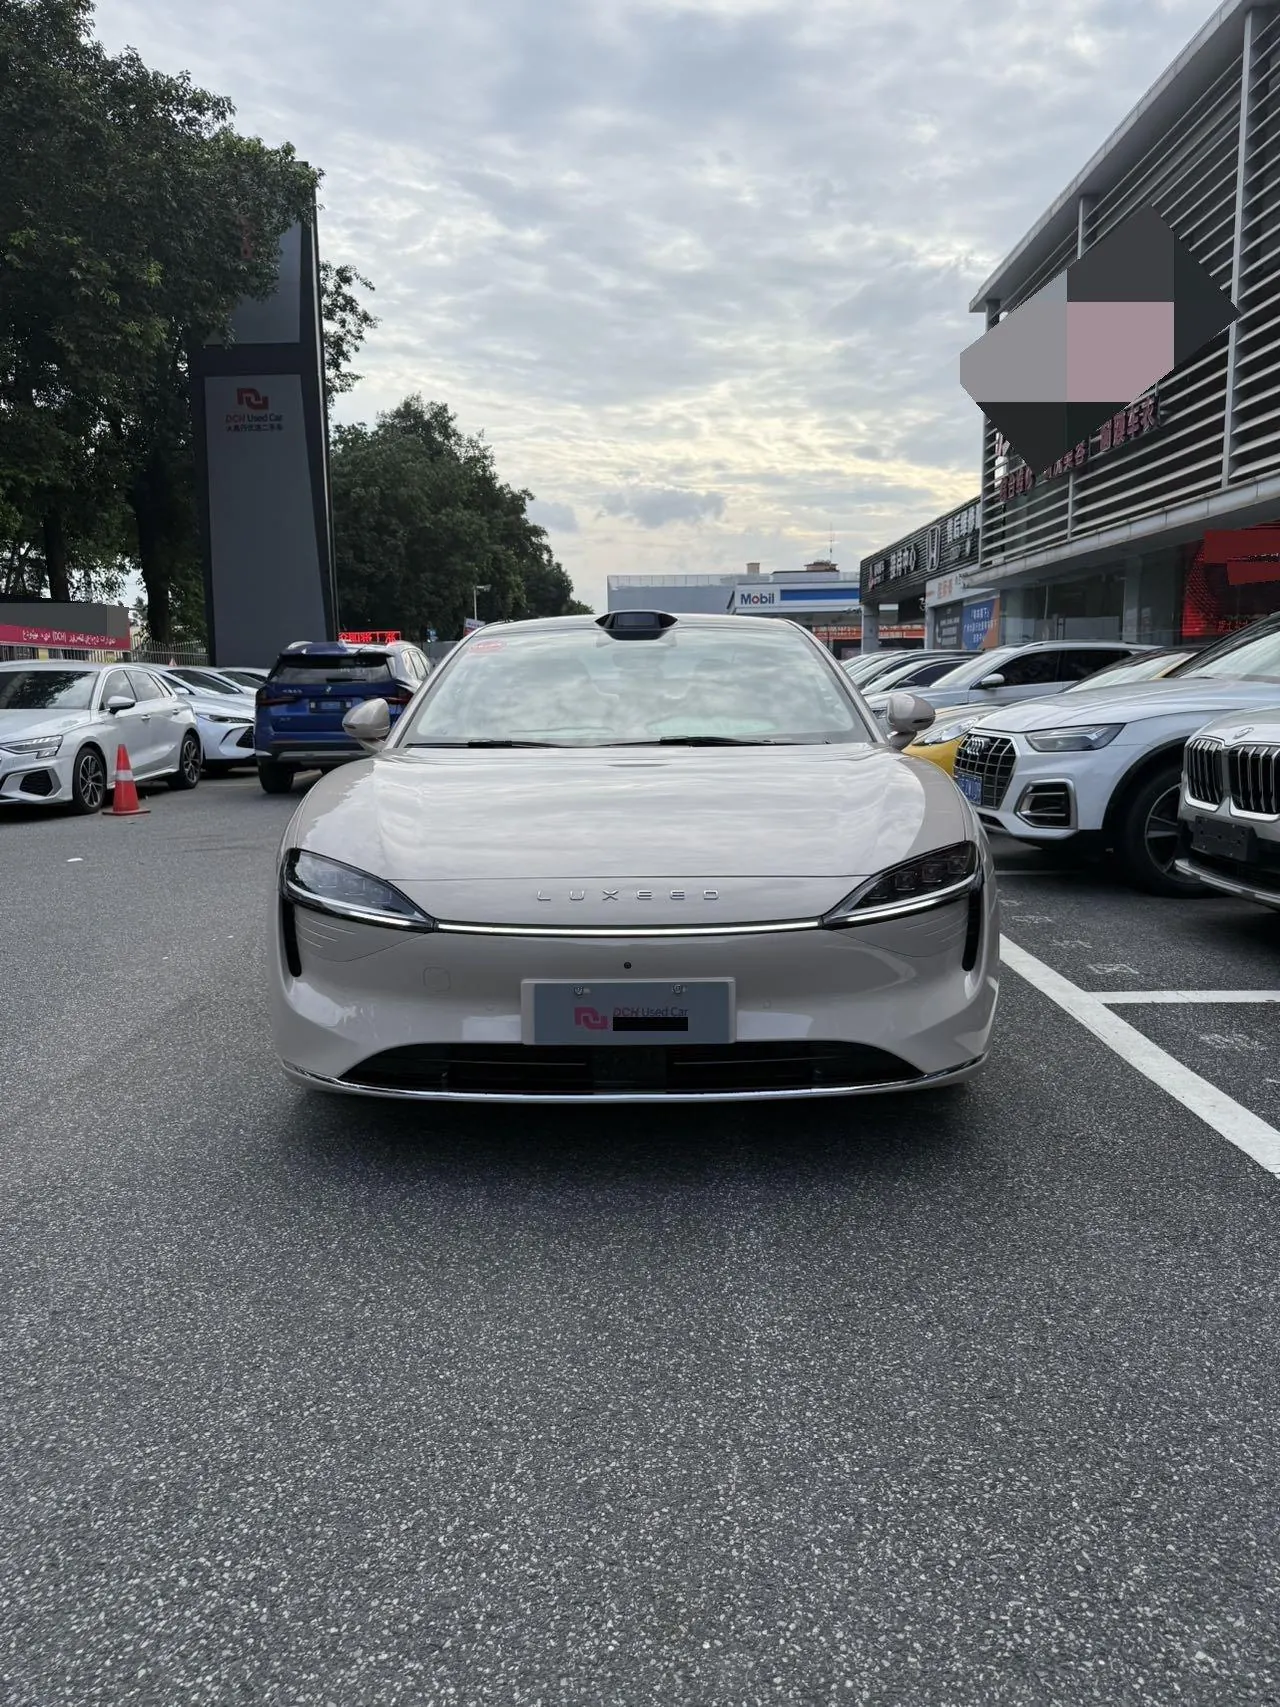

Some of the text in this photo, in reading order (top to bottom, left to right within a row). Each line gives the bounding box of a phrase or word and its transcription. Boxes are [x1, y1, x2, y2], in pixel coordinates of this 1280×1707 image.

[225, 413, 283, 423] DCH Used Car
[740, 591, 775, 605] Mobil
[536, 889, 720, 901] LUXEED
[613, 1006, 688, 1017] DCH Used Car
